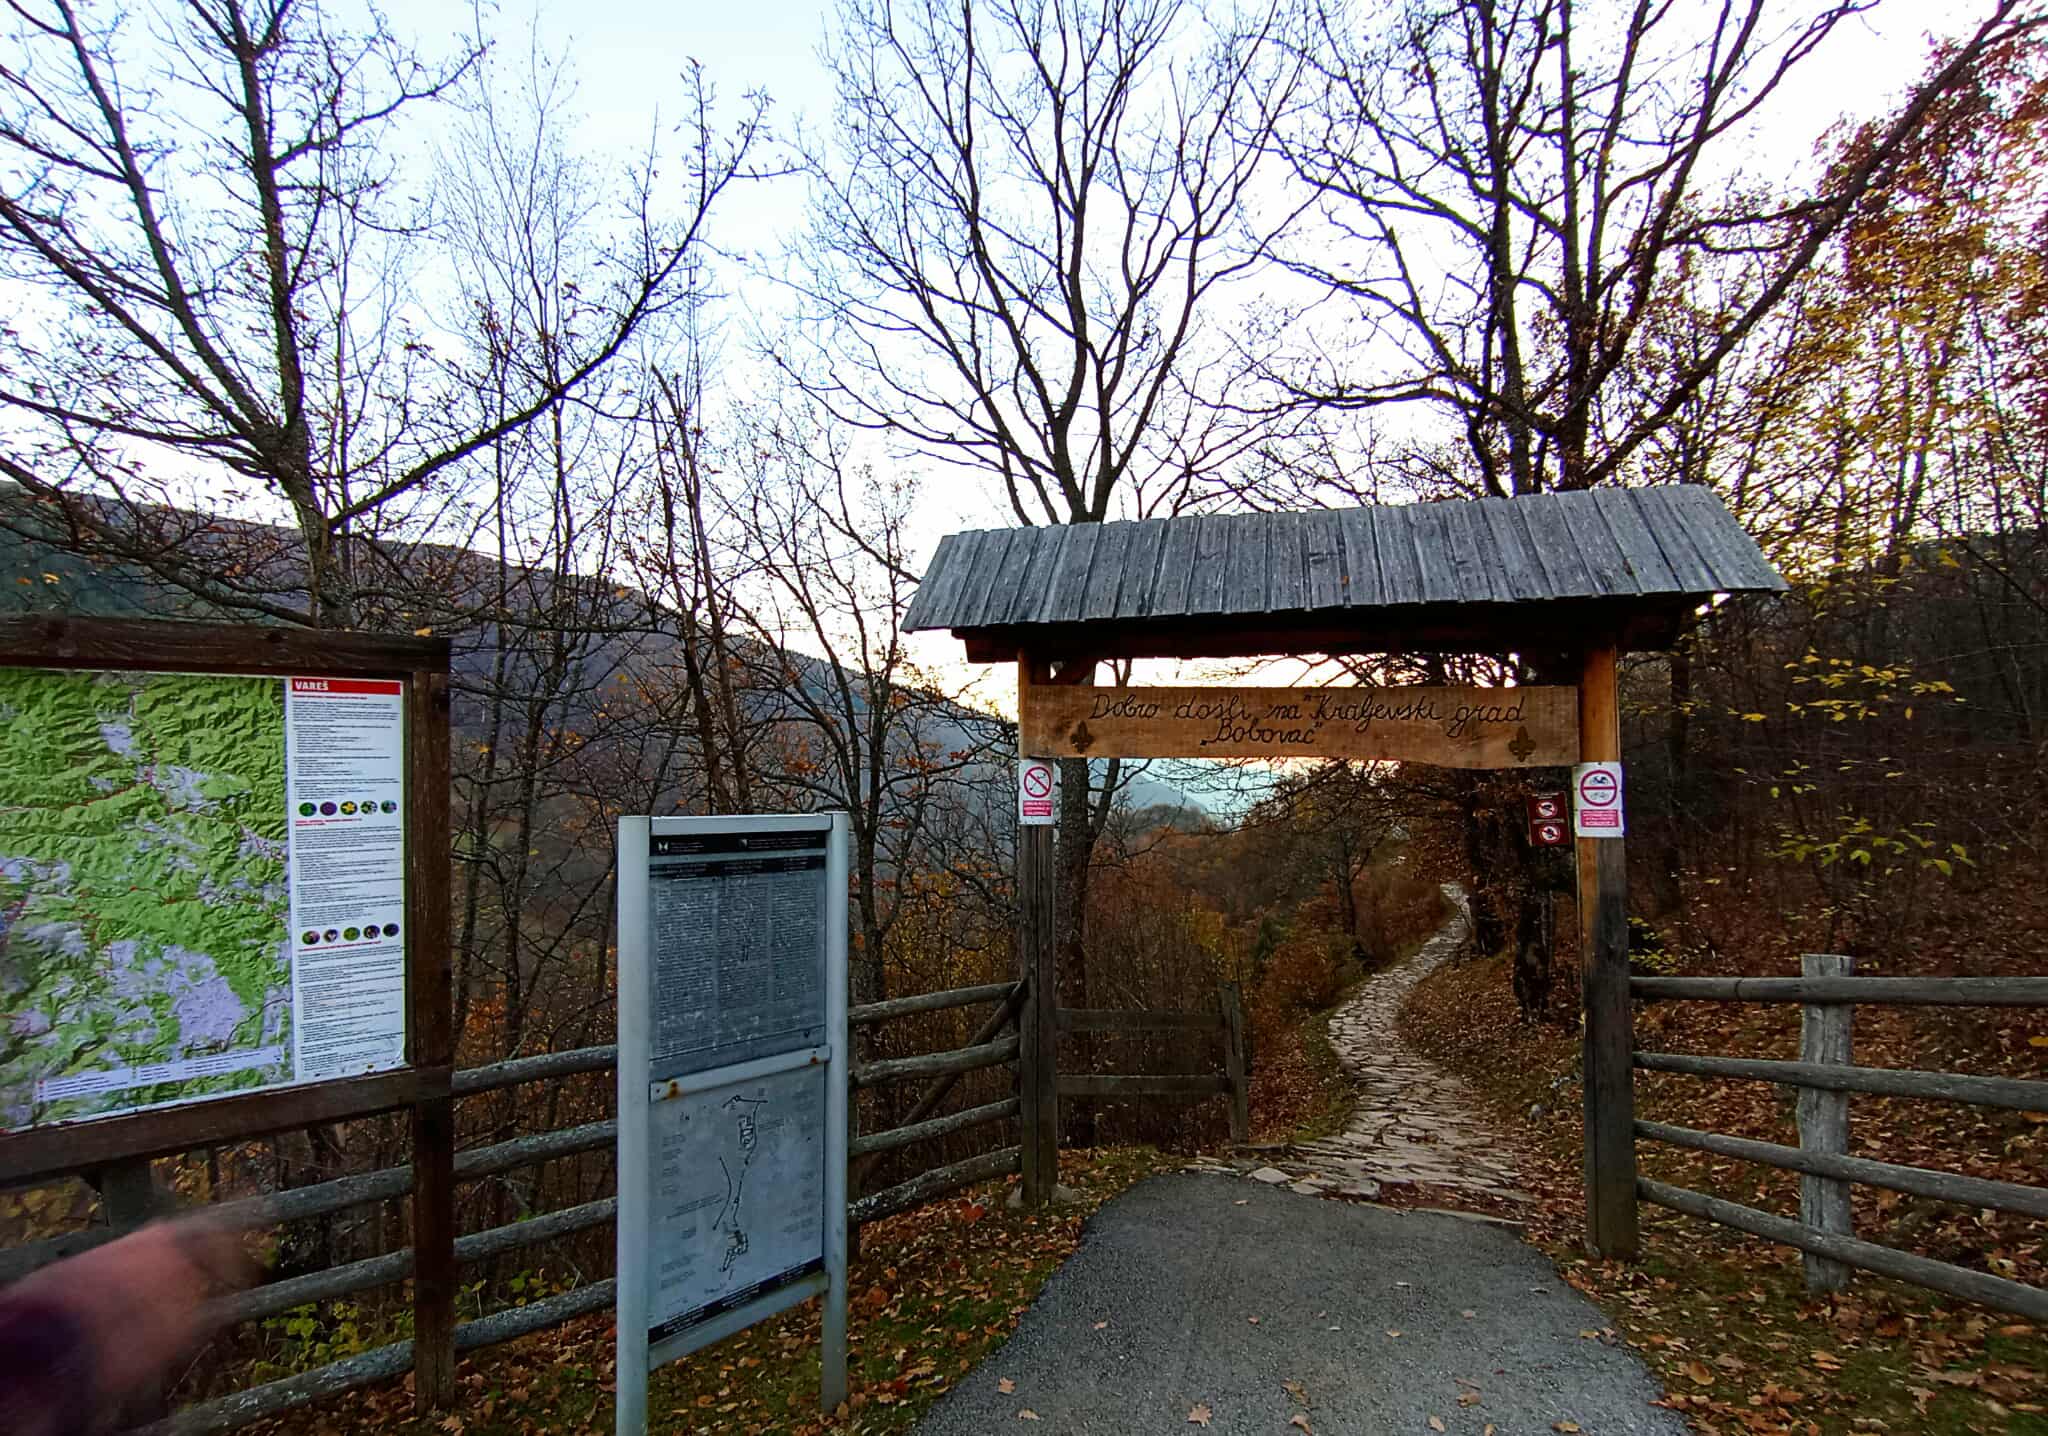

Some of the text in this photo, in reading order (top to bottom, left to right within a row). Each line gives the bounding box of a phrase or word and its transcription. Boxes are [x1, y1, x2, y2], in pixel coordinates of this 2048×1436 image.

[1090, 694, 1160, 720] Dobro
[1264, 702, 1304, 720] na
[1446, 696, 1526, 739] grad
